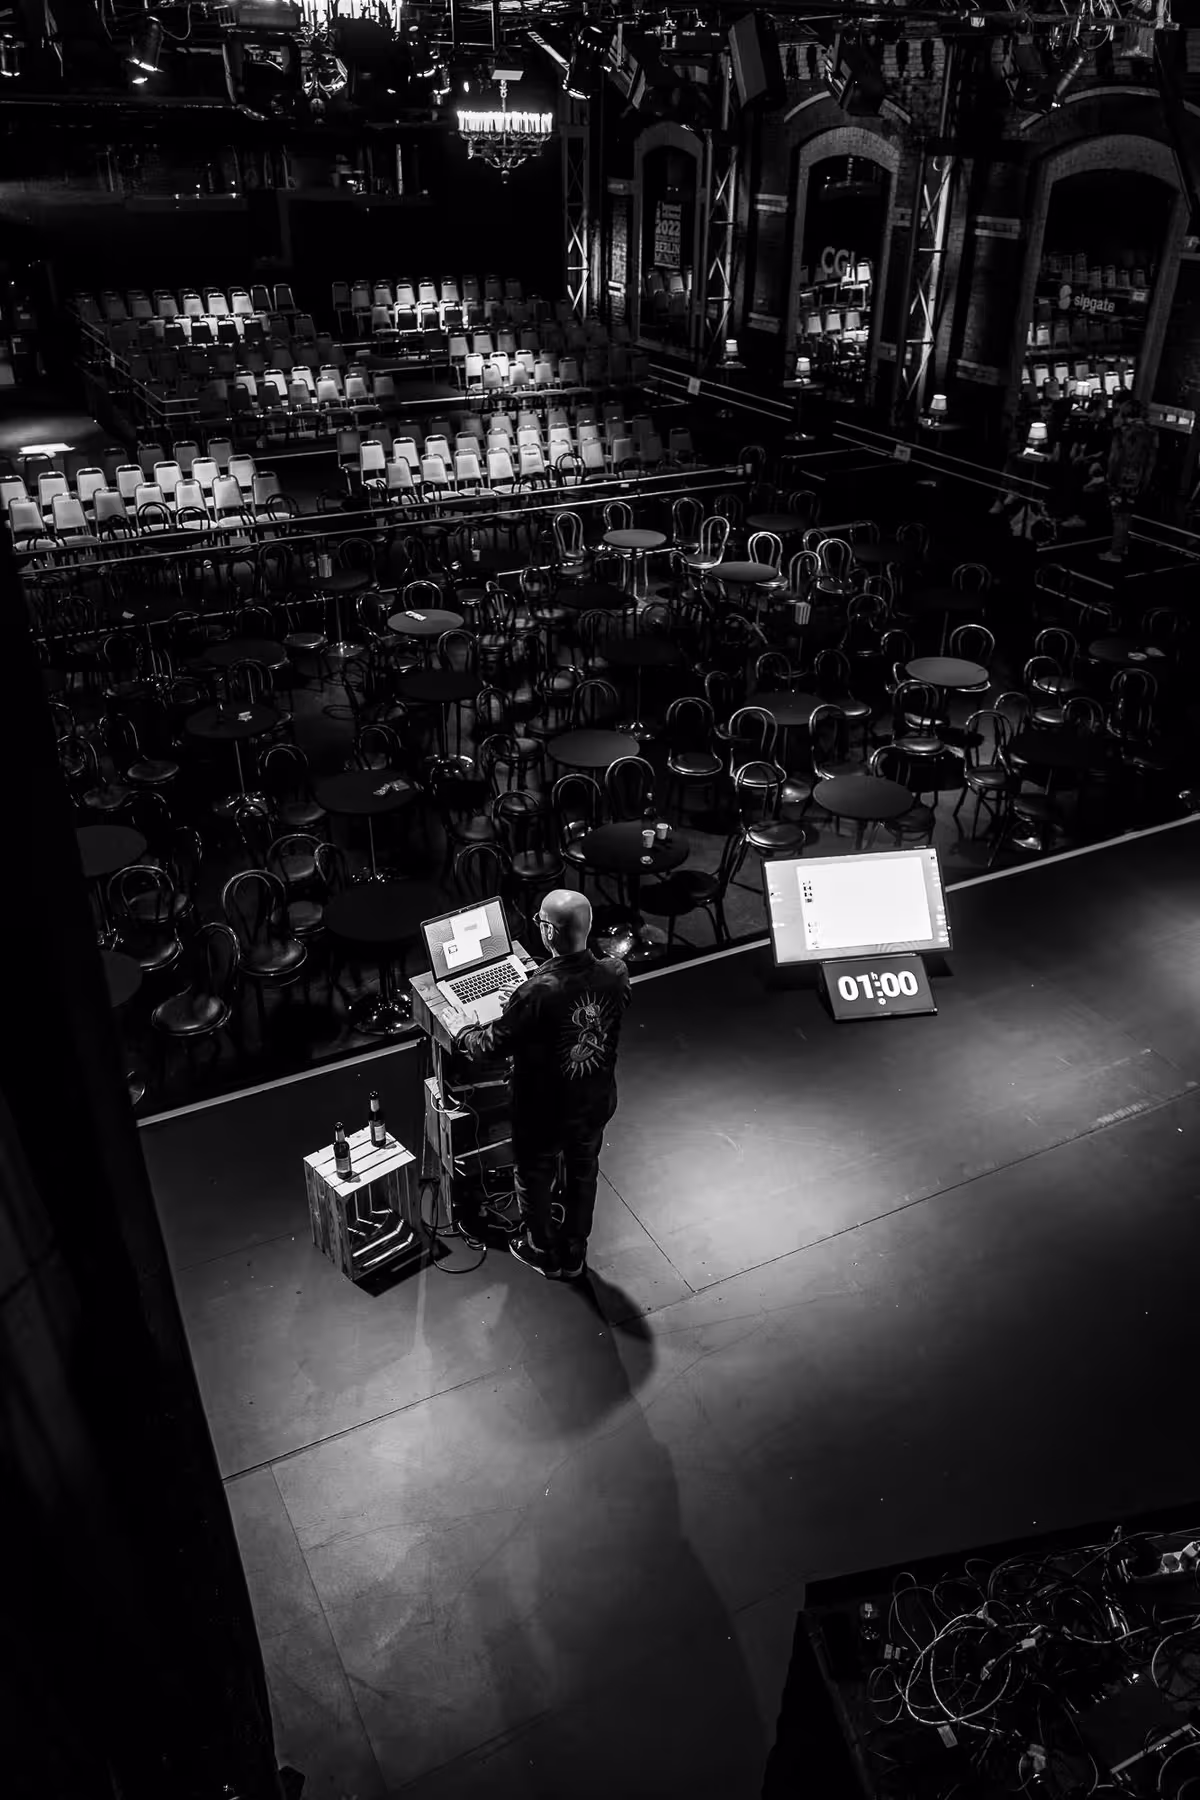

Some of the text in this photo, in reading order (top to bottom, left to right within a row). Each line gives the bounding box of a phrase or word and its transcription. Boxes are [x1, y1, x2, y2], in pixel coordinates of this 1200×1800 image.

[655, 220, 680, 236] 2022
[1074, 293, 1116, 314] sipgate
[838, 971, 918, 1001] 01:00
